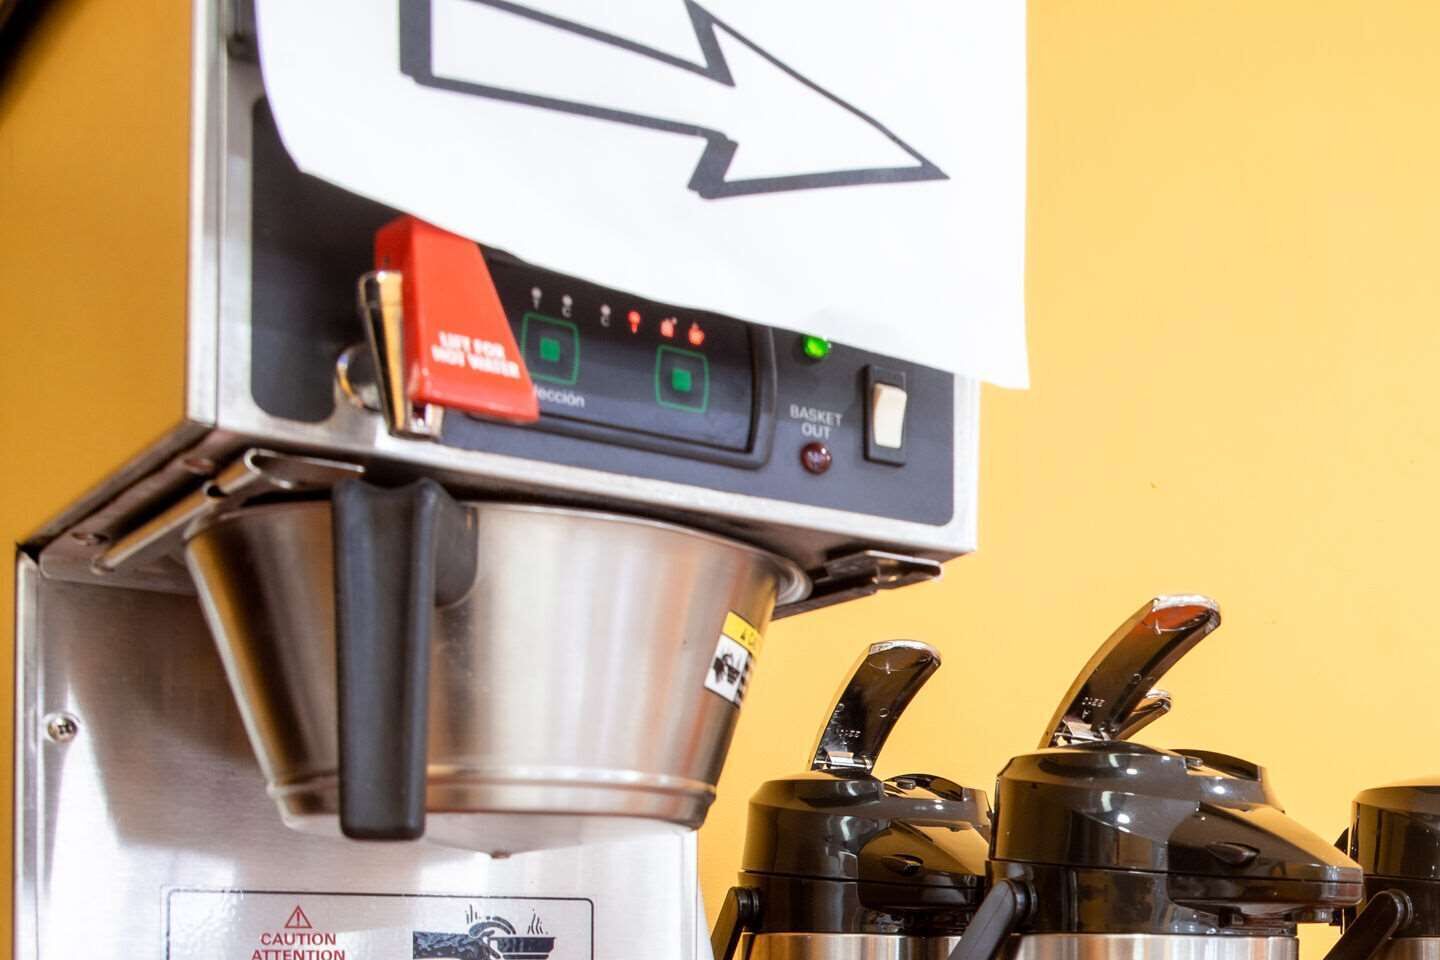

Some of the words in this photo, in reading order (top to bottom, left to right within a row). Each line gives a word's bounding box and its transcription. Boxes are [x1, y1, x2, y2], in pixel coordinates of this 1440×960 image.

[789, 404, 843, 427] BASKET
[801, 422, 832, 440] OUT
[260, 933, 336, 945] CAUTION
